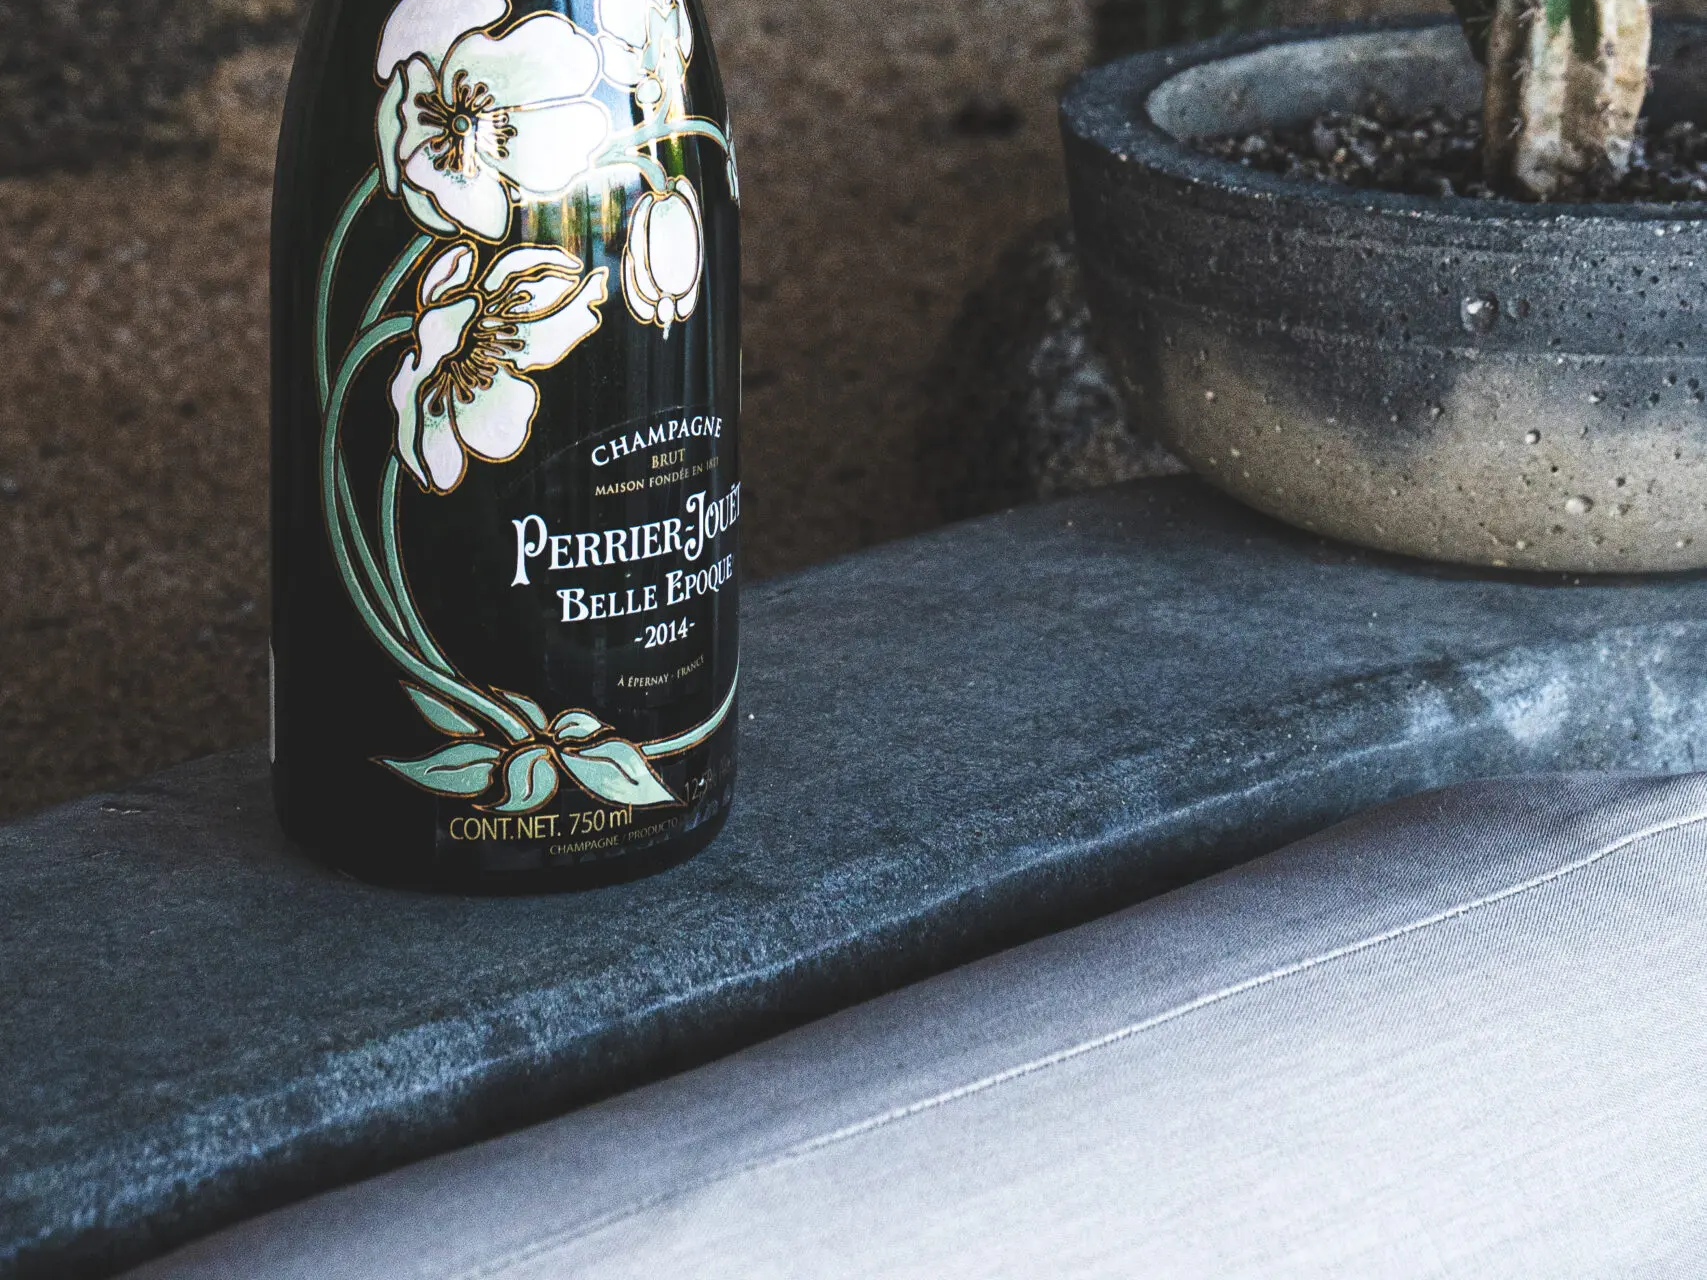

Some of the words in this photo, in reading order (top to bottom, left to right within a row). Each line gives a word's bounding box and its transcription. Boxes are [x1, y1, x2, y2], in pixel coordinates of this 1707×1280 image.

[591, 416, 722, 466] CHAMPAGNE
[651, 448, 686, 469] BRUT
[594, 478, 645, 496] MAISON
[649, 467, 690, 488] FONDÉE
[692, 463, 703, 476] EN
[510, 481, 741, 587] PERRIER-JOUËT
[556, 585, 658, 622] BELLE
[627, 666, 669, 688] ÉPERNAY
[677, 655, 705, 678] FRANCE
[569, 809, 604, 835] 750
[609, 802, 633, 826] ml
[549, 835, 619, 856] CHAMPAGNE
[628, 817, 679, 842] PRODUCTO
